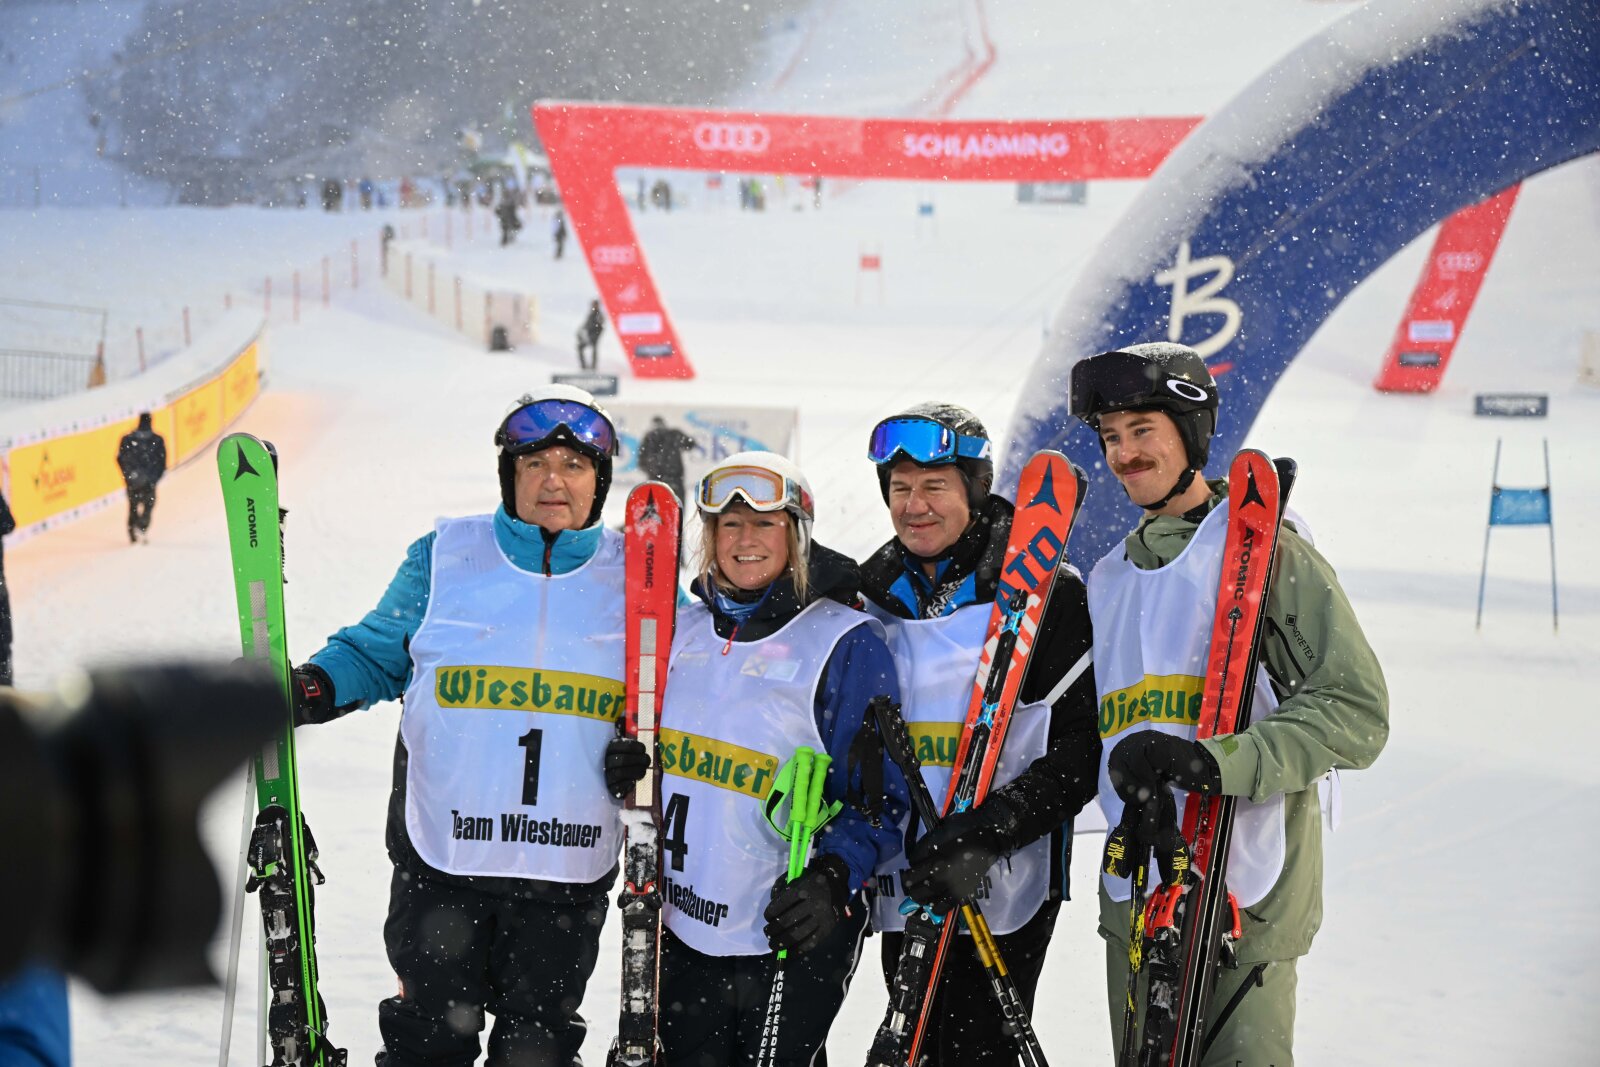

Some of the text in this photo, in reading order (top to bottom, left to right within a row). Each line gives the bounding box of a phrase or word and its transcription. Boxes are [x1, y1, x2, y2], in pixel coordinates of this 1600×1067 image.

[903, 133, 1070, 158] SCHLADMING
[246, 497, 258, 549] ATOMIC
[645, 540, 654, 589] ATOMIC
[1234, 526, 1255, 601] ATOMIC
[438, 668, 625, 718] Wiesbauer
[518, 728, 543, 806] 1
[659, 736, 771, 794] sbauer
[451, 810, 602, 848] Team Wiesbauer
[663, 792, 690, 873] 4
